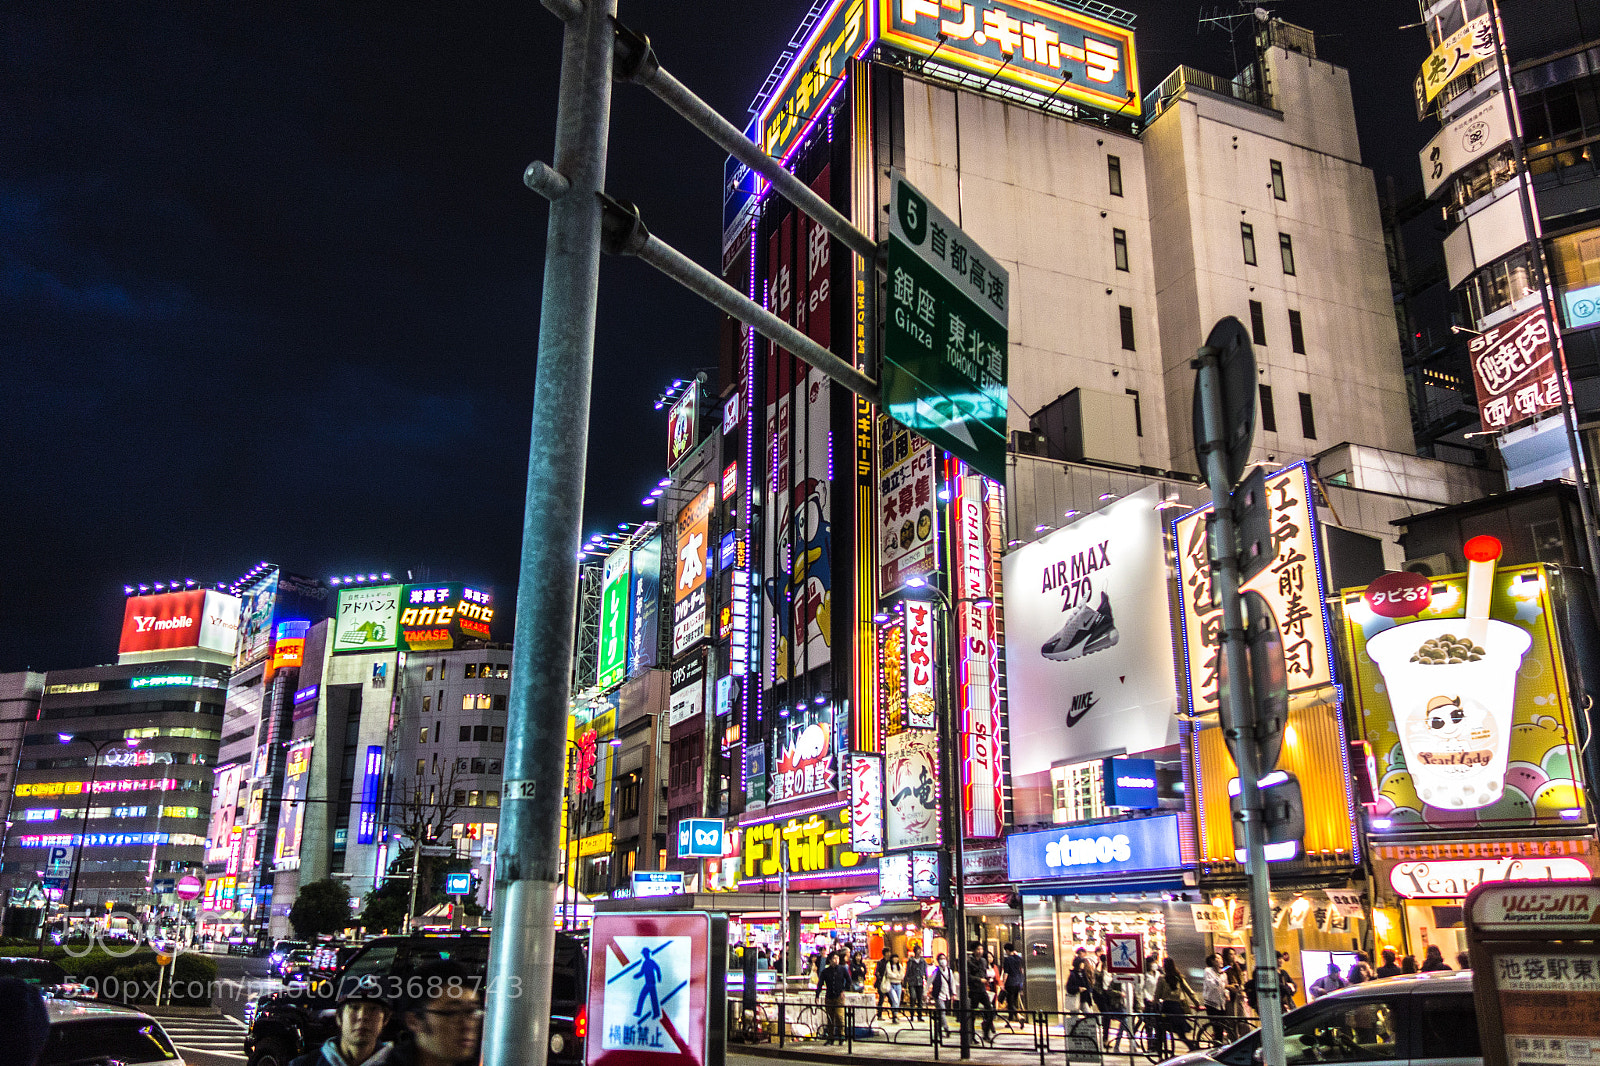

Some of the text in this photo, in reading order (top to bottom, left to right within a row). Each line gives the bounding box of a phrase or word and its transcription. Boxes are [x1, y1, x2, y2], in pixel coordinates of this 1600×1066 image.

[907, 199, 918, 229] 5
[930, 221, 1004, 311] 首都高速
[894, 267, 935, 327] 銀座
[895, 307, 933, 349] Ginza
[948, 312, 1003, 381] 東北道
[1470, 329, 1499, 352] 5F
[946, 344, 977, 382] TOHOKU
[1482, 318, 1550, 389] 焼肉
[857, 392, 871, 477] ン.キホーテ
[912, 453, 926, 477] FC
[884, 475, 930, 527] 大募集
[1042, 540, 1111, 593] AIR MAX
[1270, 477, 1312, 679] 江戸前寿司
[410, 588, 450, 604] 洋菓子
[463, 588, 490, 603] 洋菓子
[1061, 576, 1093, 612] 270
[1372, 585, 1428, 606] タピる?
[342, 599, 396, 614] アドバンス
[400, 606, 455, 626] タカセ
[457, 600, 494, 622] タカセ
[133, 616, 193, 632] Y!mobile
[459, 618, 490, 634] TAKASE
[608, 589, 619, 665] レイク
[403, 629, 449, 642] TAKASE
[970, 636, 986, 657] S
[1071, 692, 1093, 712] NIKE
[975, 721, 988, 770] SLOT
[1419, 749, 1490, 768] Pearl Lady
[520, 782, 535, 797] 12
[853, 758, 871, 827] ラーメン
[1117, 776, 1154, 788] atmos
[51, 848, 67, 864] P
[1046, 834, 1131, 867] atmos
[1477, 846, 1510, 854] CREPES
[1501, 894, 1590, 913] リムジンバス
[1504, 911, 1590, 923] Airport Limousine
[609, 1023, 663, 1048] 横断禁止
[1515, 1038, 1562, 1051] 時刻表
